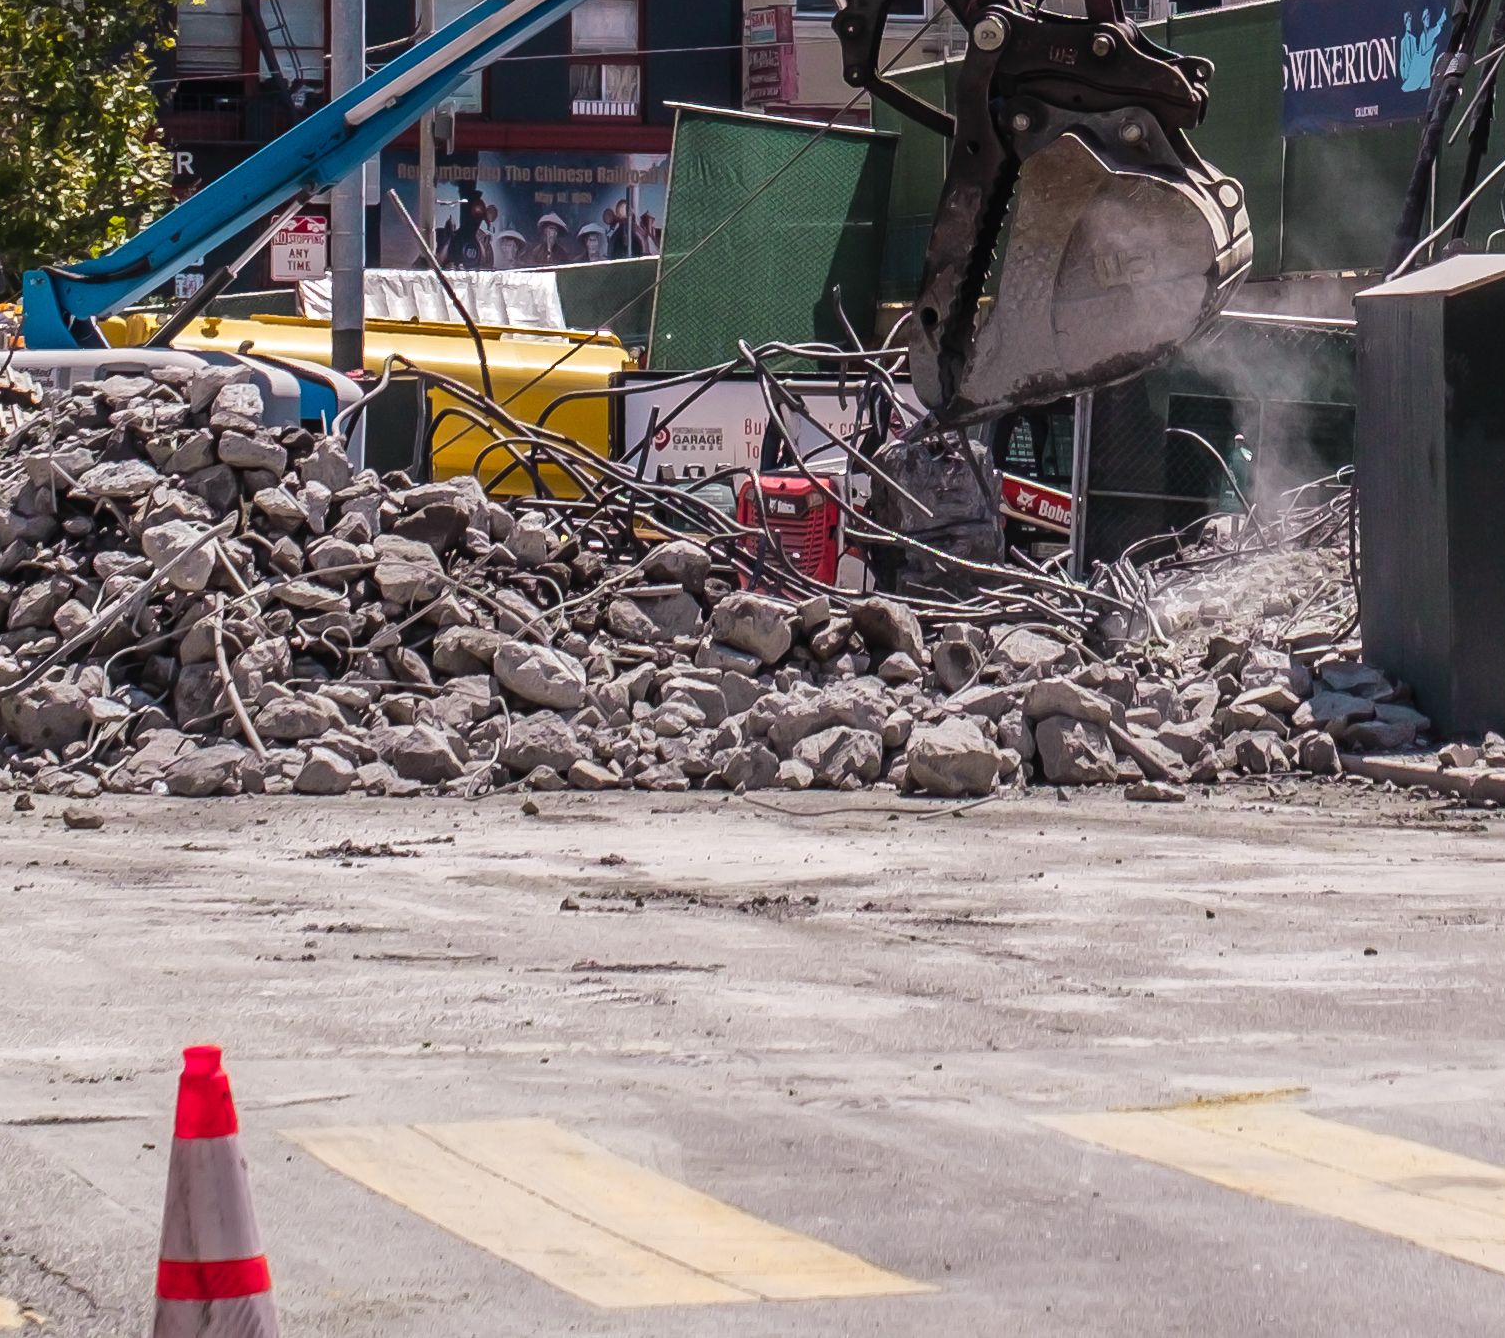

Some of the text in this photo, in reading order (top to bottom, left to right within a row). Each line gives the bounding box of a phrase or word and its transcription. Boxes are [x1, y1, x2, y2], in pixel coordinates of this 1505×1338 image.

[505, 164, 531, 182] The
[534, 165, 593, 184] Chinese
[289, 233, 324, 245] STOPPING
[288, 248, 310, 259] ANY
[287, 261, 311, 272] TIME
[672, 434, 723, 445] GARAGE
